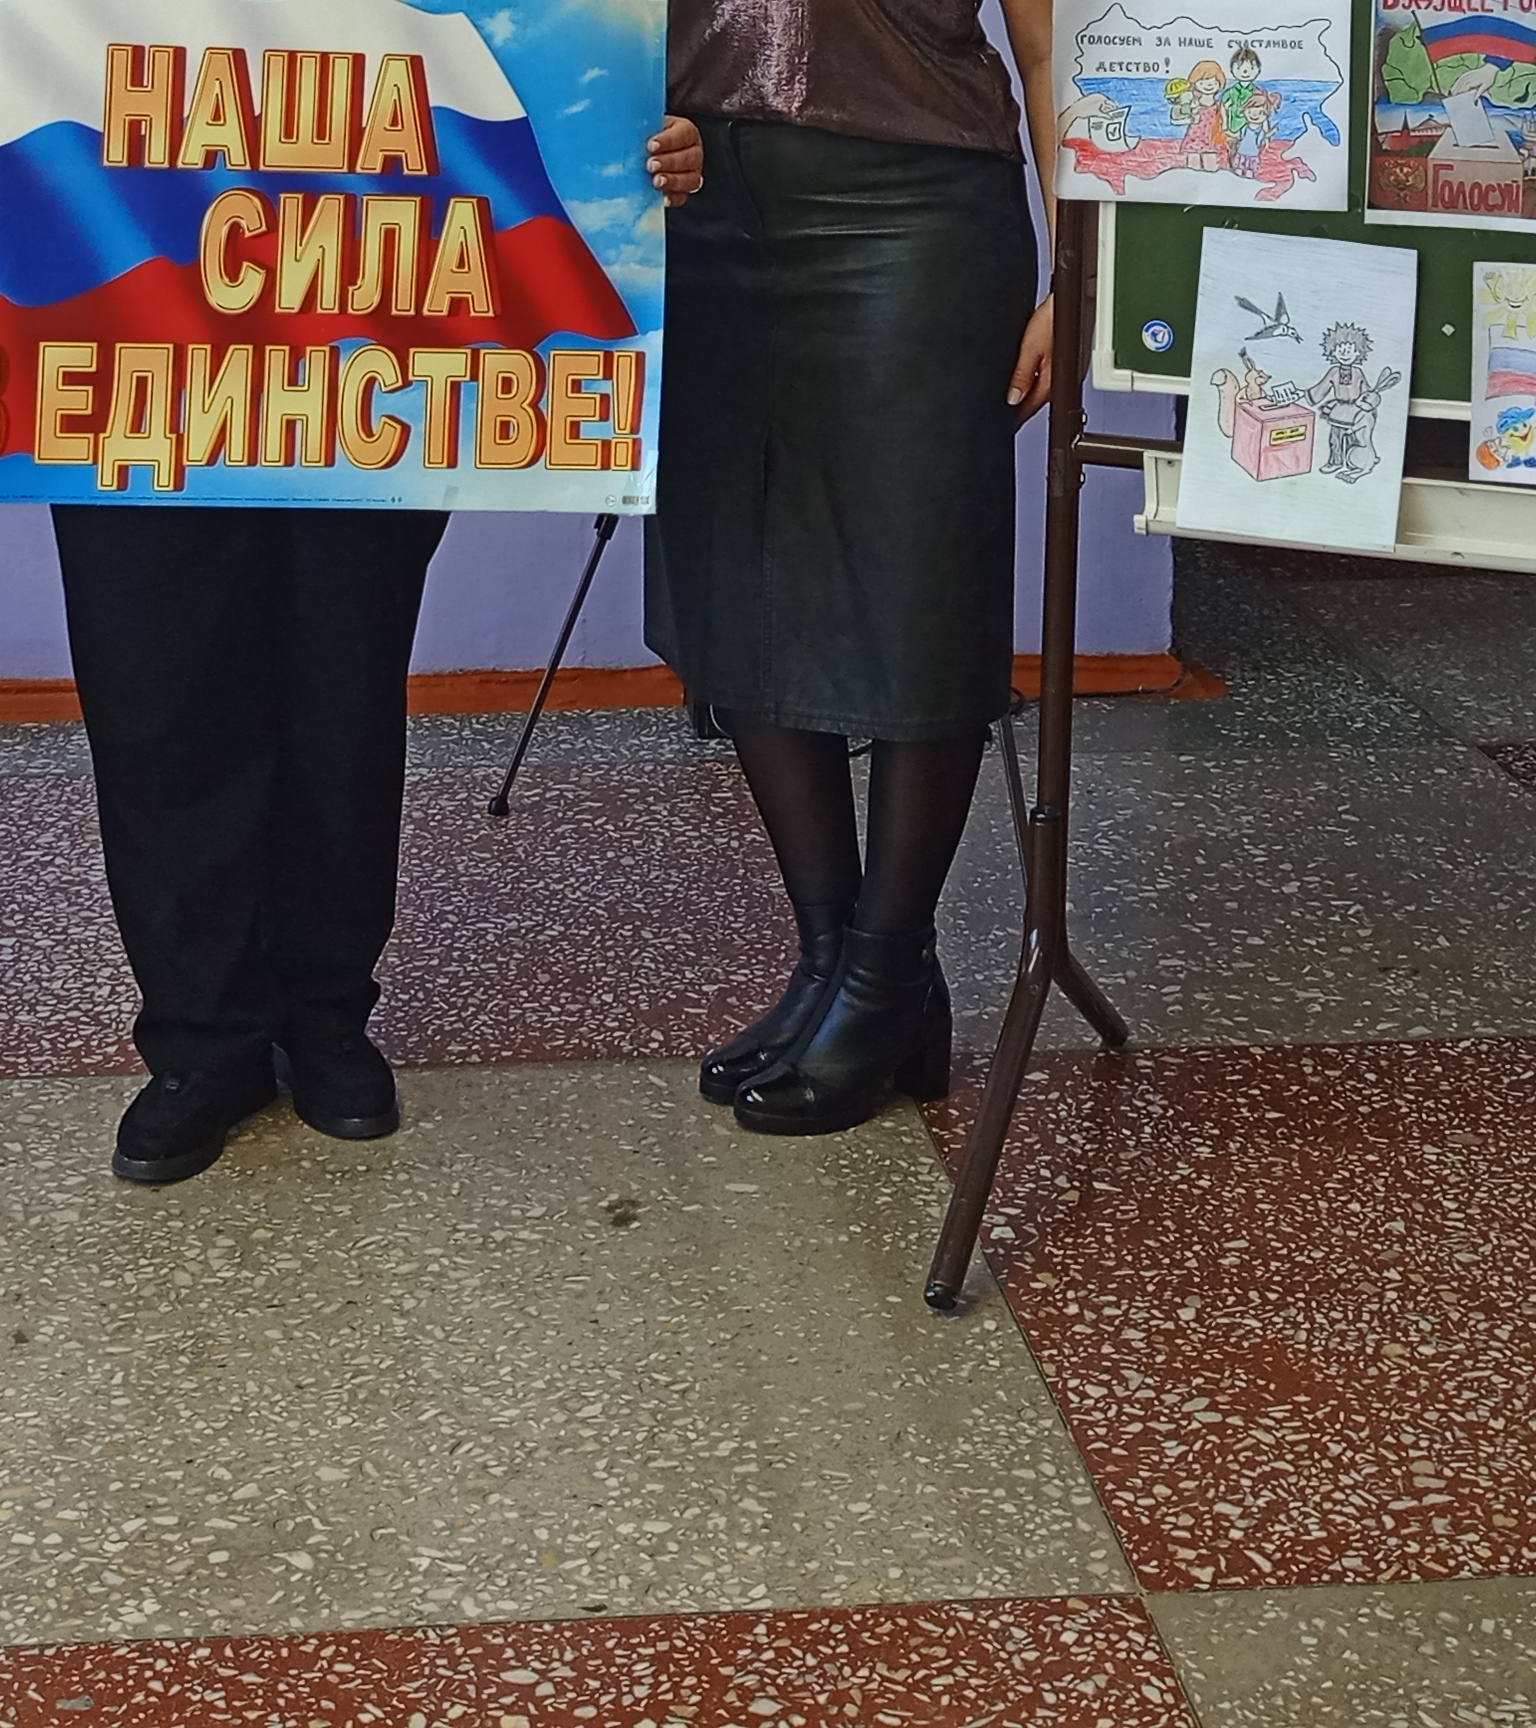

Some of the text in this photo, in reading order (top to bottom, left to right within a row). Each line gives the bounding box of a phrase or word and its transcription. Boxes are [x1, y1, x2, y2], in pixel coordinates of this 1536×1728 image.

[1079, 34, 1305, 51] ГОЛОСУЕМ ЗА НАШЕ СЧАСТЛИВОЕ
[102, 44, 439, 176] НАША
[197, 186, 503, 319] СИЛА
[32, 339, 648, 492] ЕДИНСТВЕ!
